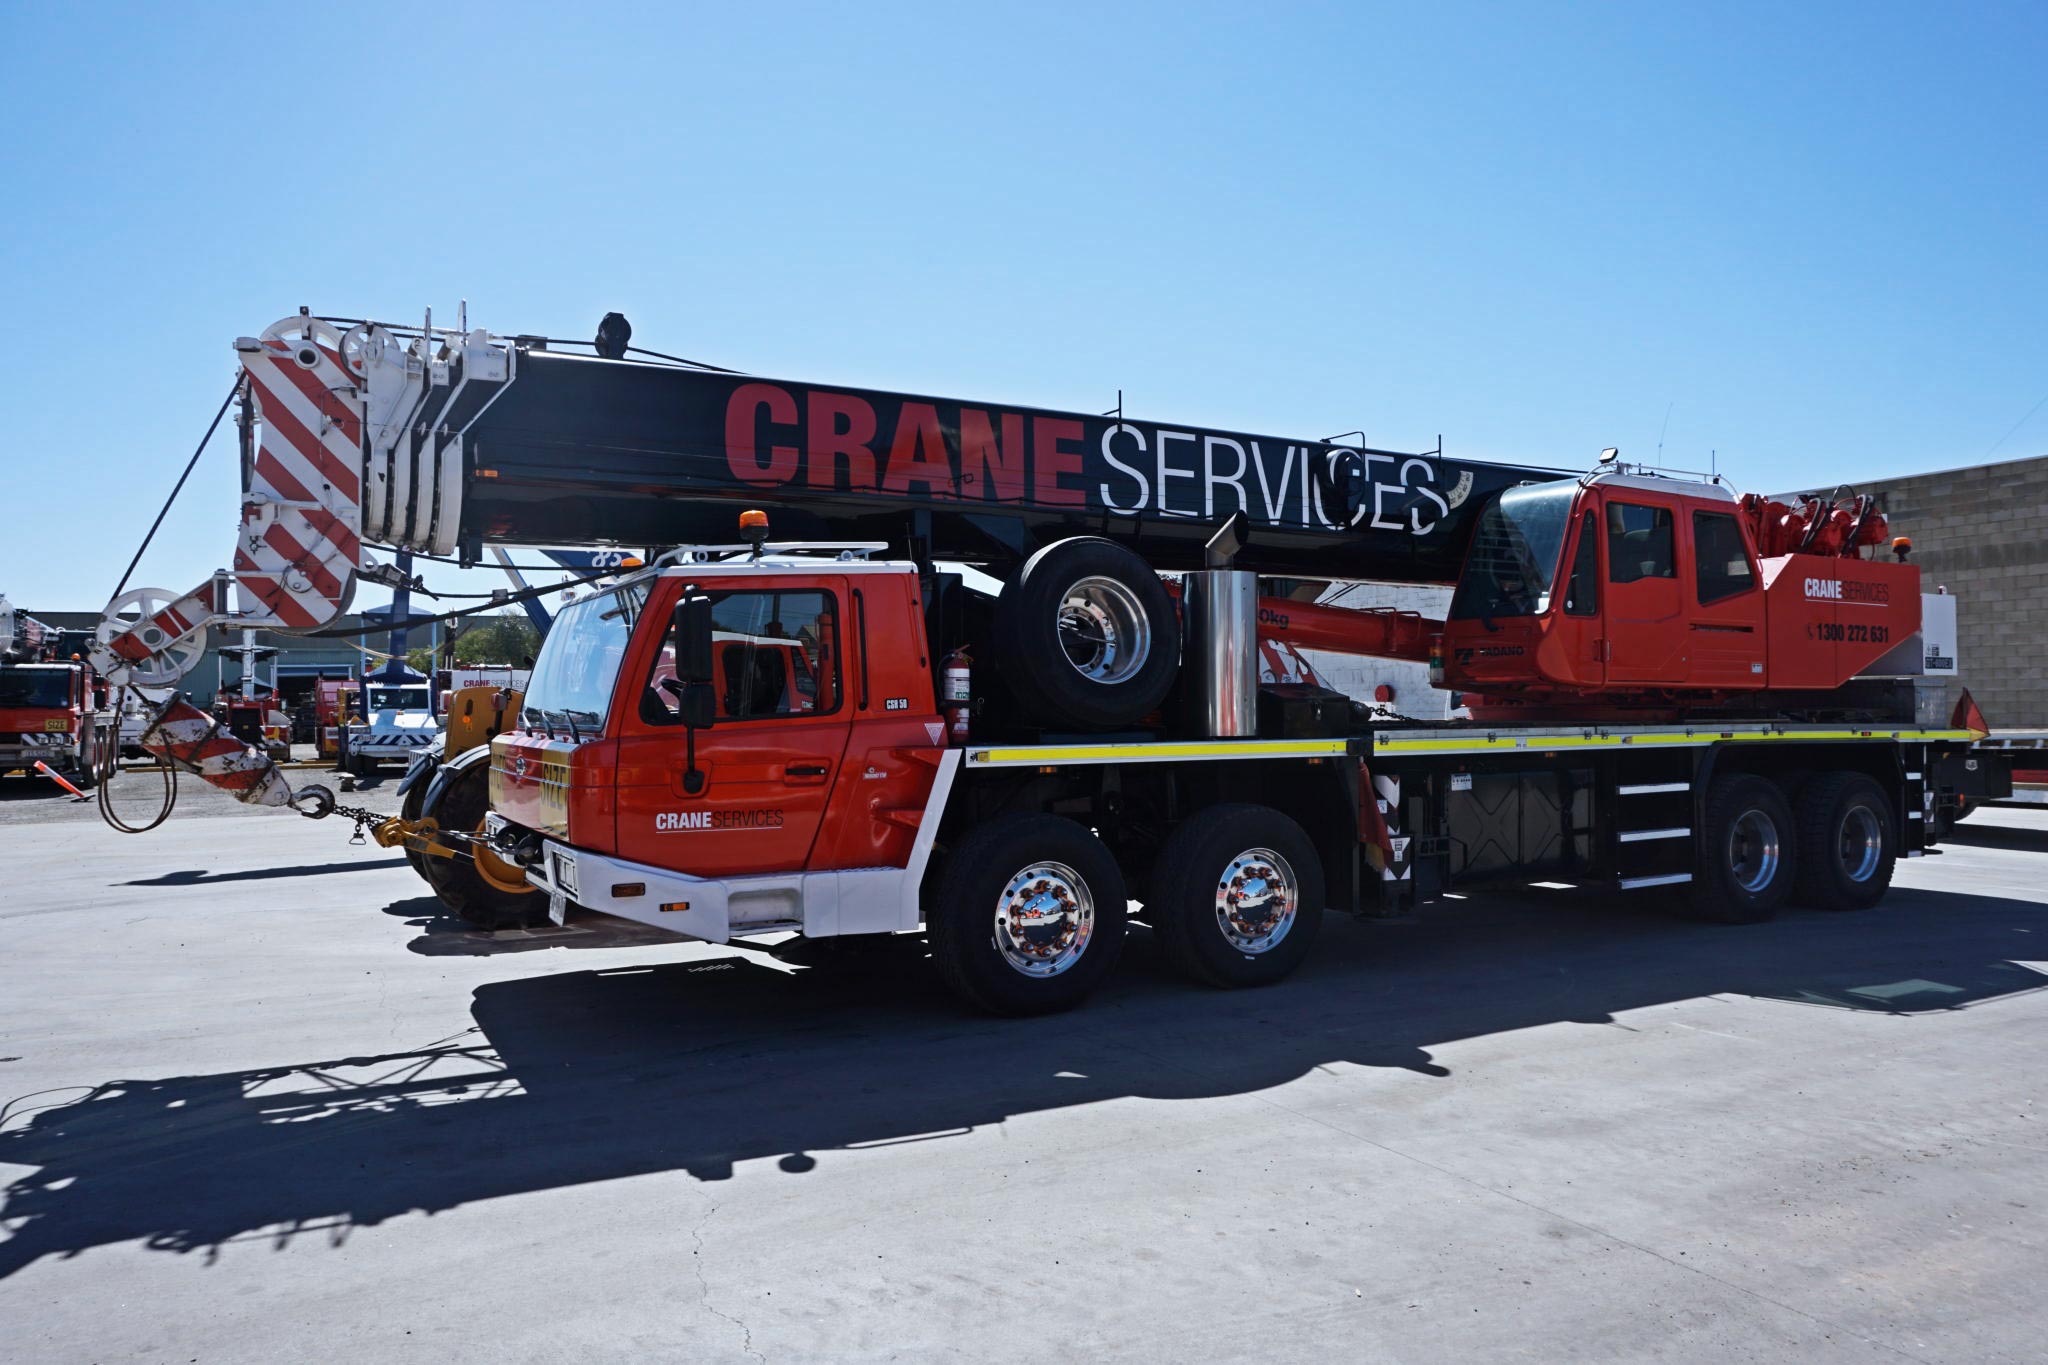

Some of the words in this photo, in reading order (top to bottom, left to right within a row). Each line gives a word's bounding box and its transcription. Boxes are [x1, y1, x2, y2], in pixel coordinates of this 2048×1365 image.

[724, 383, 1086, 510] CRANE
[1099, 424, 1450, 535] SERVICES
[1804, 578, 1842, 599] CRANE
[1842, 581, 1889, 602] SERVICES
[1259, 608, 1289, 630] 0kg
[1817, 623, 1845, 641] 1300
[1848, 624, 1867, 642] 272
[1870, 625, 1889, 643] 631
[463, 679, 490, 688] CRANE
[47, 721, 65, 730] SIZE
[656, 812, 712, 830] CRANE
[712, 809, 784, 827] SERVICES
